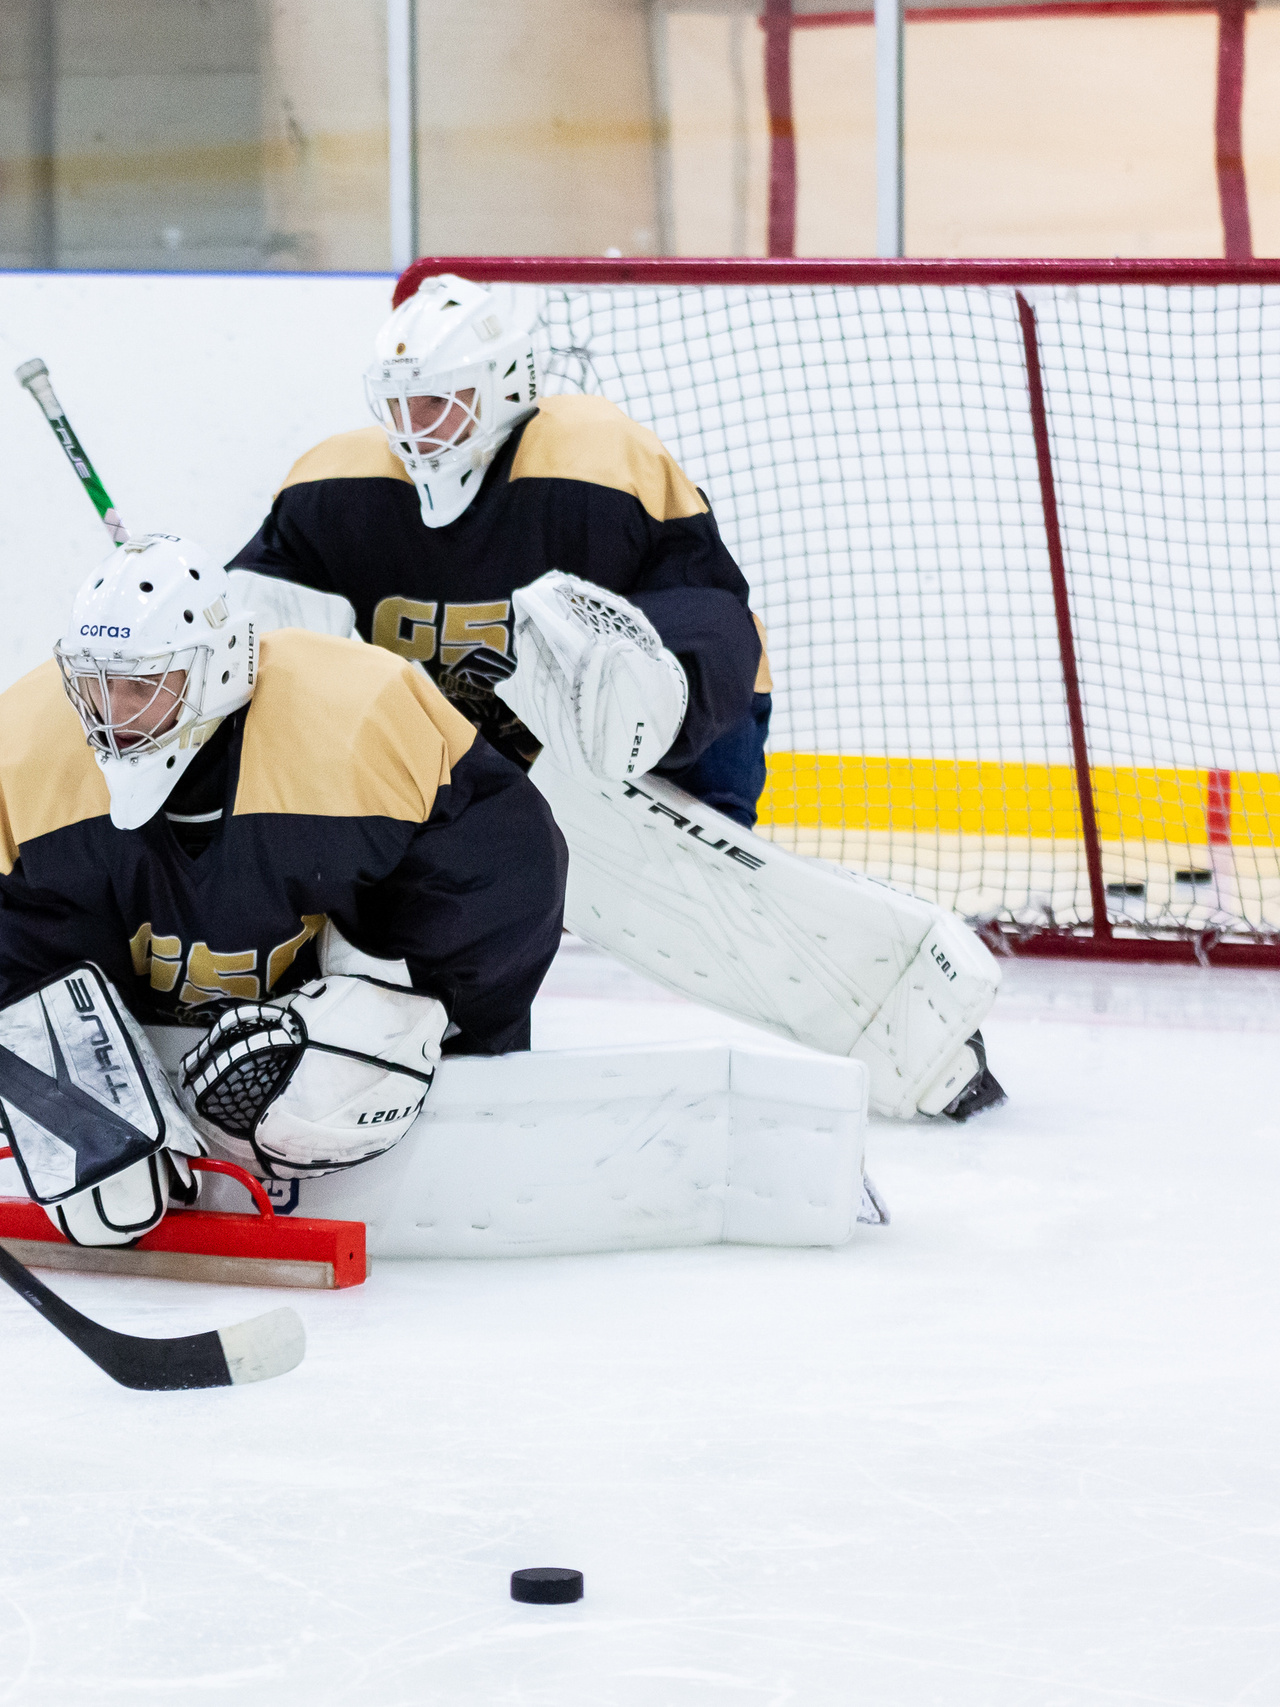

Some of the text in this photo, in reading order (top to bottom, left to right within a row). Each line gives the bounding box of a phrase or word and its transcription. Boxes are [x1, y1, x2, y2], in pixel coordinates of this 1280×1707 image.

[622, 780, 767, 871] TRUE
[930, 943, 957, 982] L20.1
[63, 977, 129, 1104] TRUE
[356, 1106, 412, 1125] L20.1
